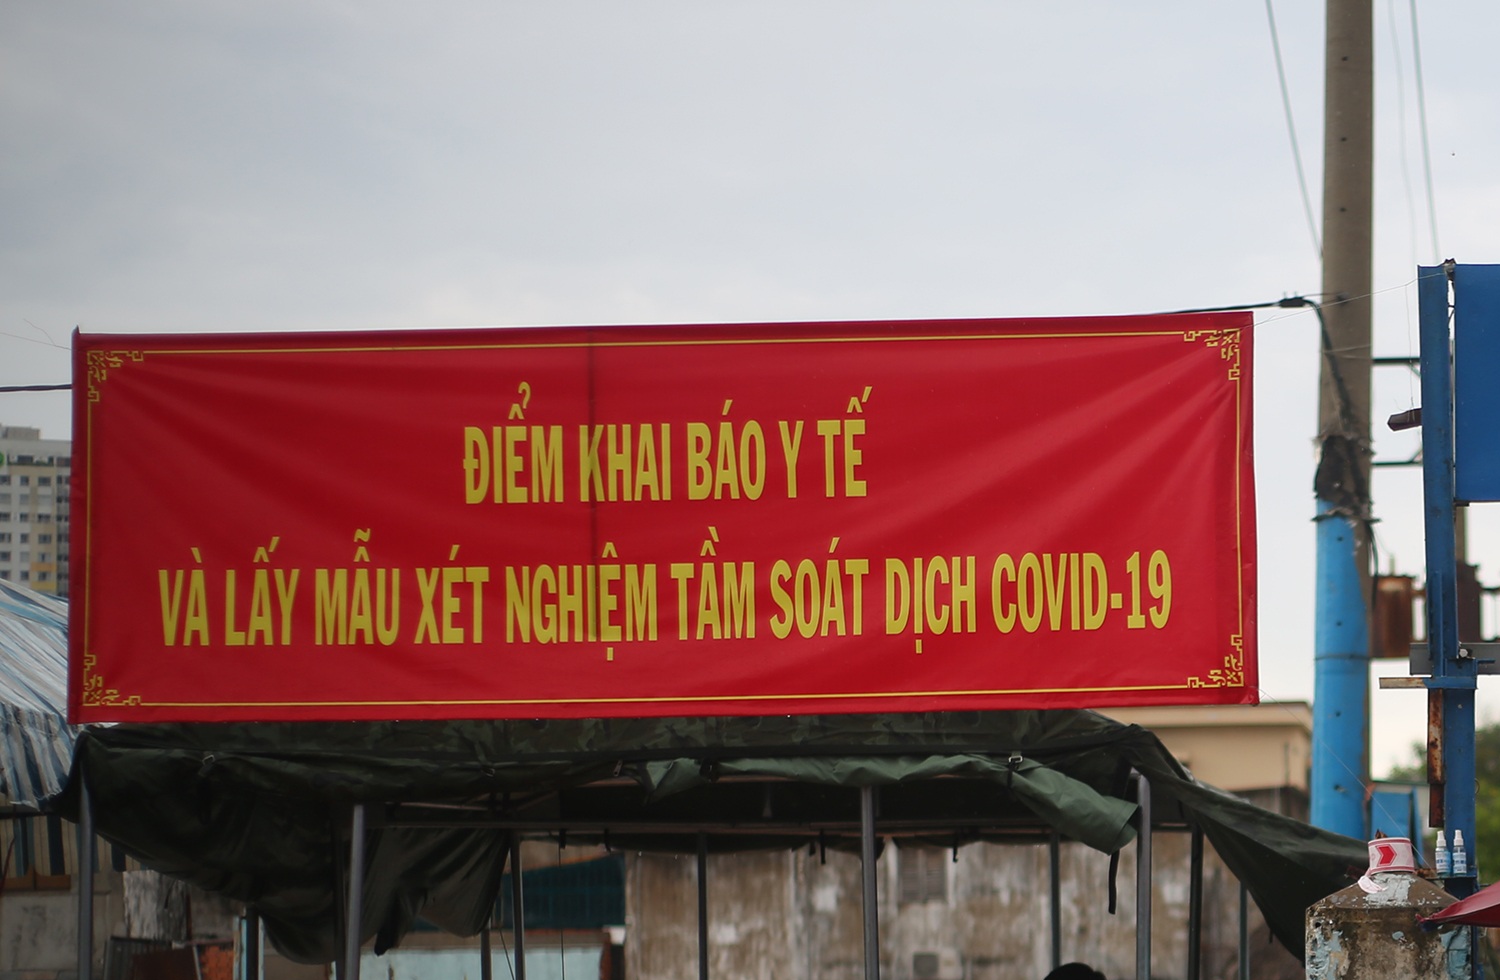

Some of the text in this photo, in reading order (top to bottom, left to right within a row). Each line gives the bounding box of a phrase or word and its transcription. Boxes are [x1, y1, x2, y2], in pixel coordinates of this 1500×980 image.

[463, 382, 872, 504] ĐIỂM KHAI BÁO Y TẾ
[158, 526, 1172, 661] VÀ LẤY MẪU XÉT NGHIỆM TẦM SOÁT DỊCH COVID-19
